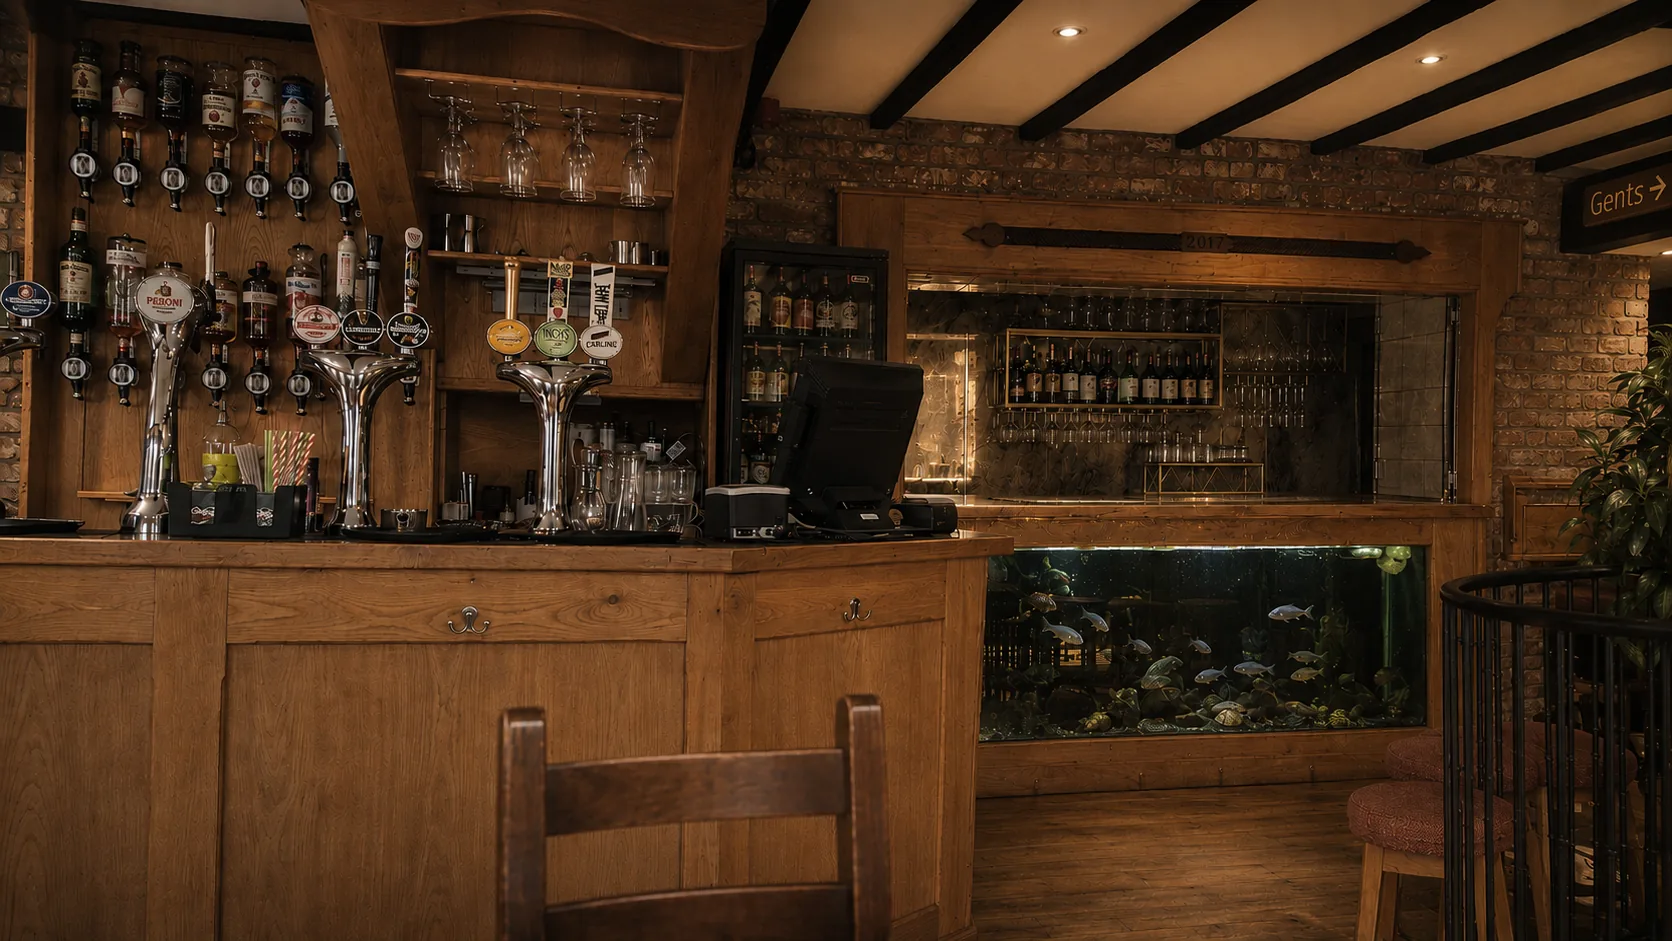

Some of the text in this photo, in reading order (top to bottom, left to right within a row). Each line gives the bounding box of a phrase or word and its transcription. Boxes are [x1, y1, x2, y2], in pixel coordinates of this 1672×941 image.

[1591, 183, 1644, 216] Gents
[1186, 234, 1224, 250] 2017
[586, 340, 618, 349] CARLING
